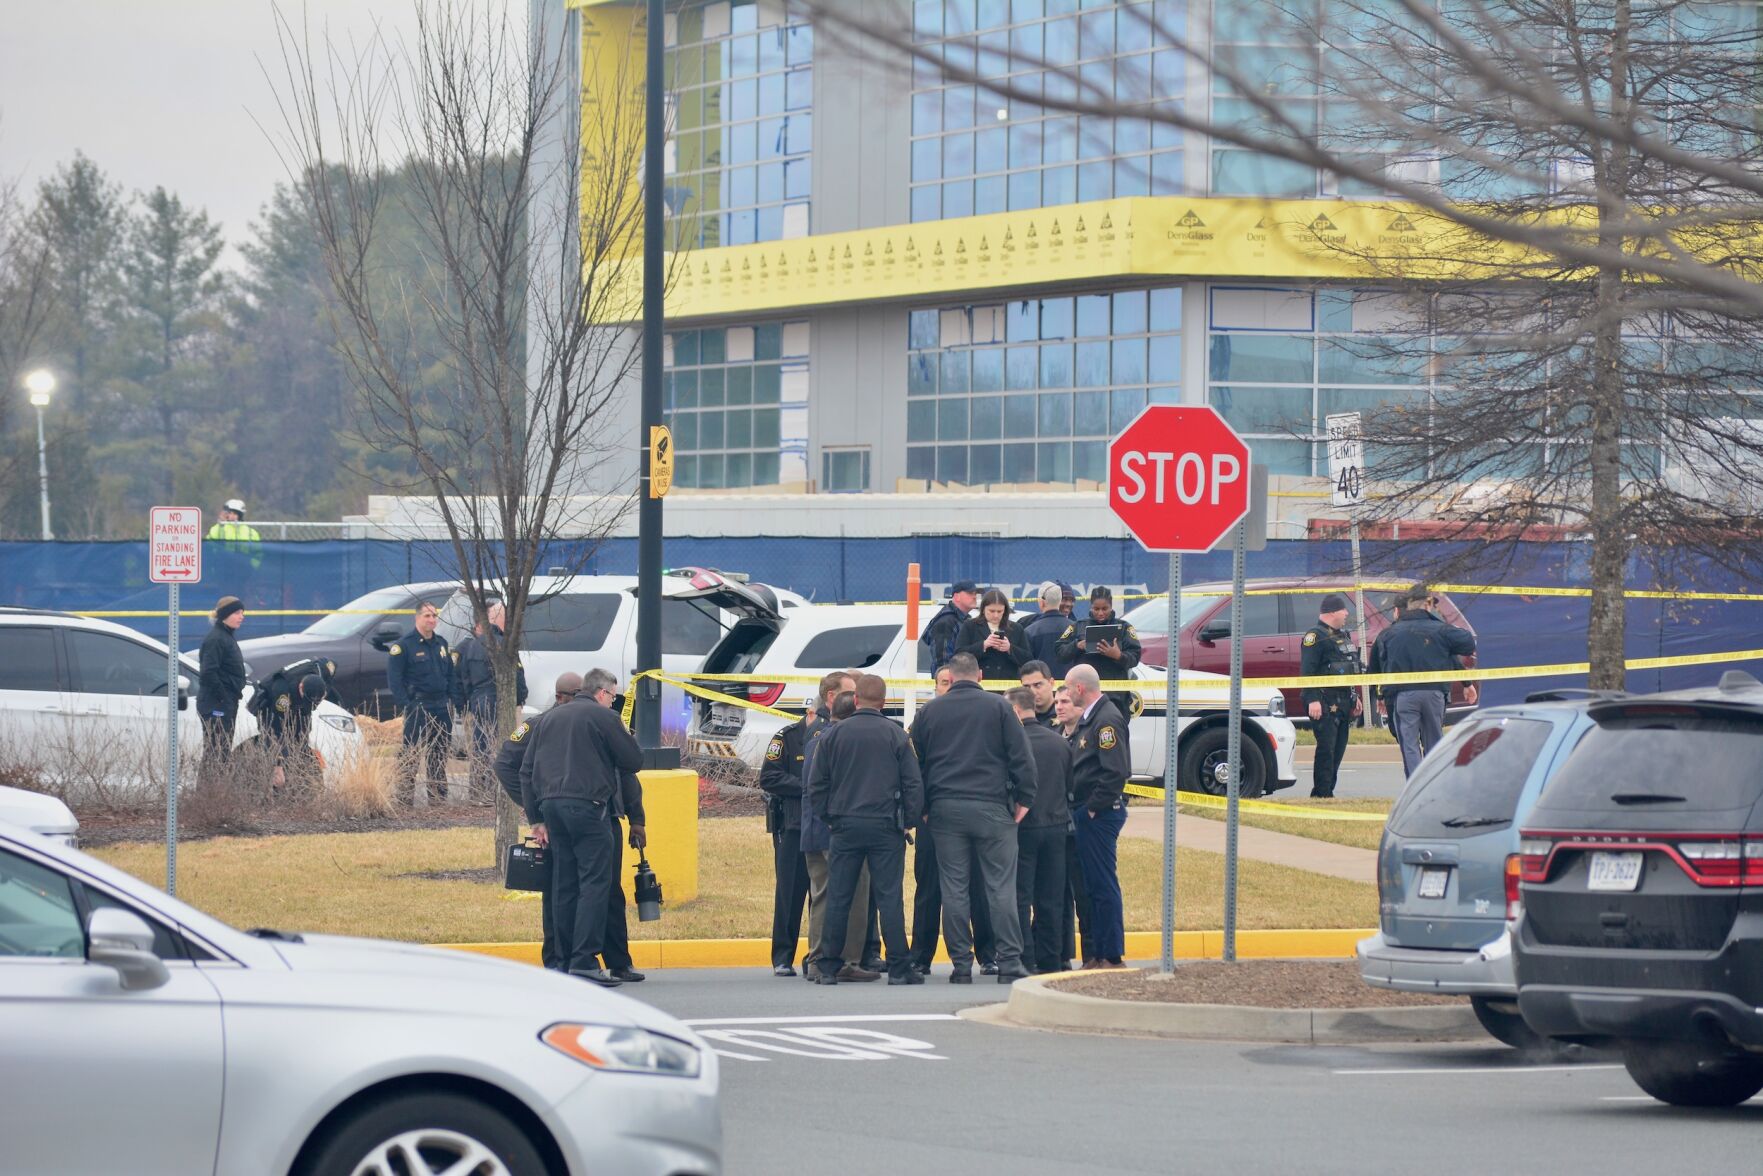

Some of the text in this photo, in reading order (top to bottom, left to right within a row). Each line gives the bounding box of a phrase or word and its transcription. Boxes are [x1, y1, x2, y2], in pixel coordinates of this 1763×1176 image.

[1181, 216, 1199, 225] GP
[1313, 219, 1331, 229] GP
[1166, 230, 1214, 241] DensGlass
[1335, 444, 1356, 459] LIMIT
[1117, 450, 1241, 505] STOP
[1338, 465, 1359, 499] 40
[169, 512, 182, 522] NO
[155, 525, 196, 534] PARKING
[157, 543, 194, 553] STANDING
[155, 555, 196, 567] FIRE LANE
[697, 1026, 951, 1061] OP
